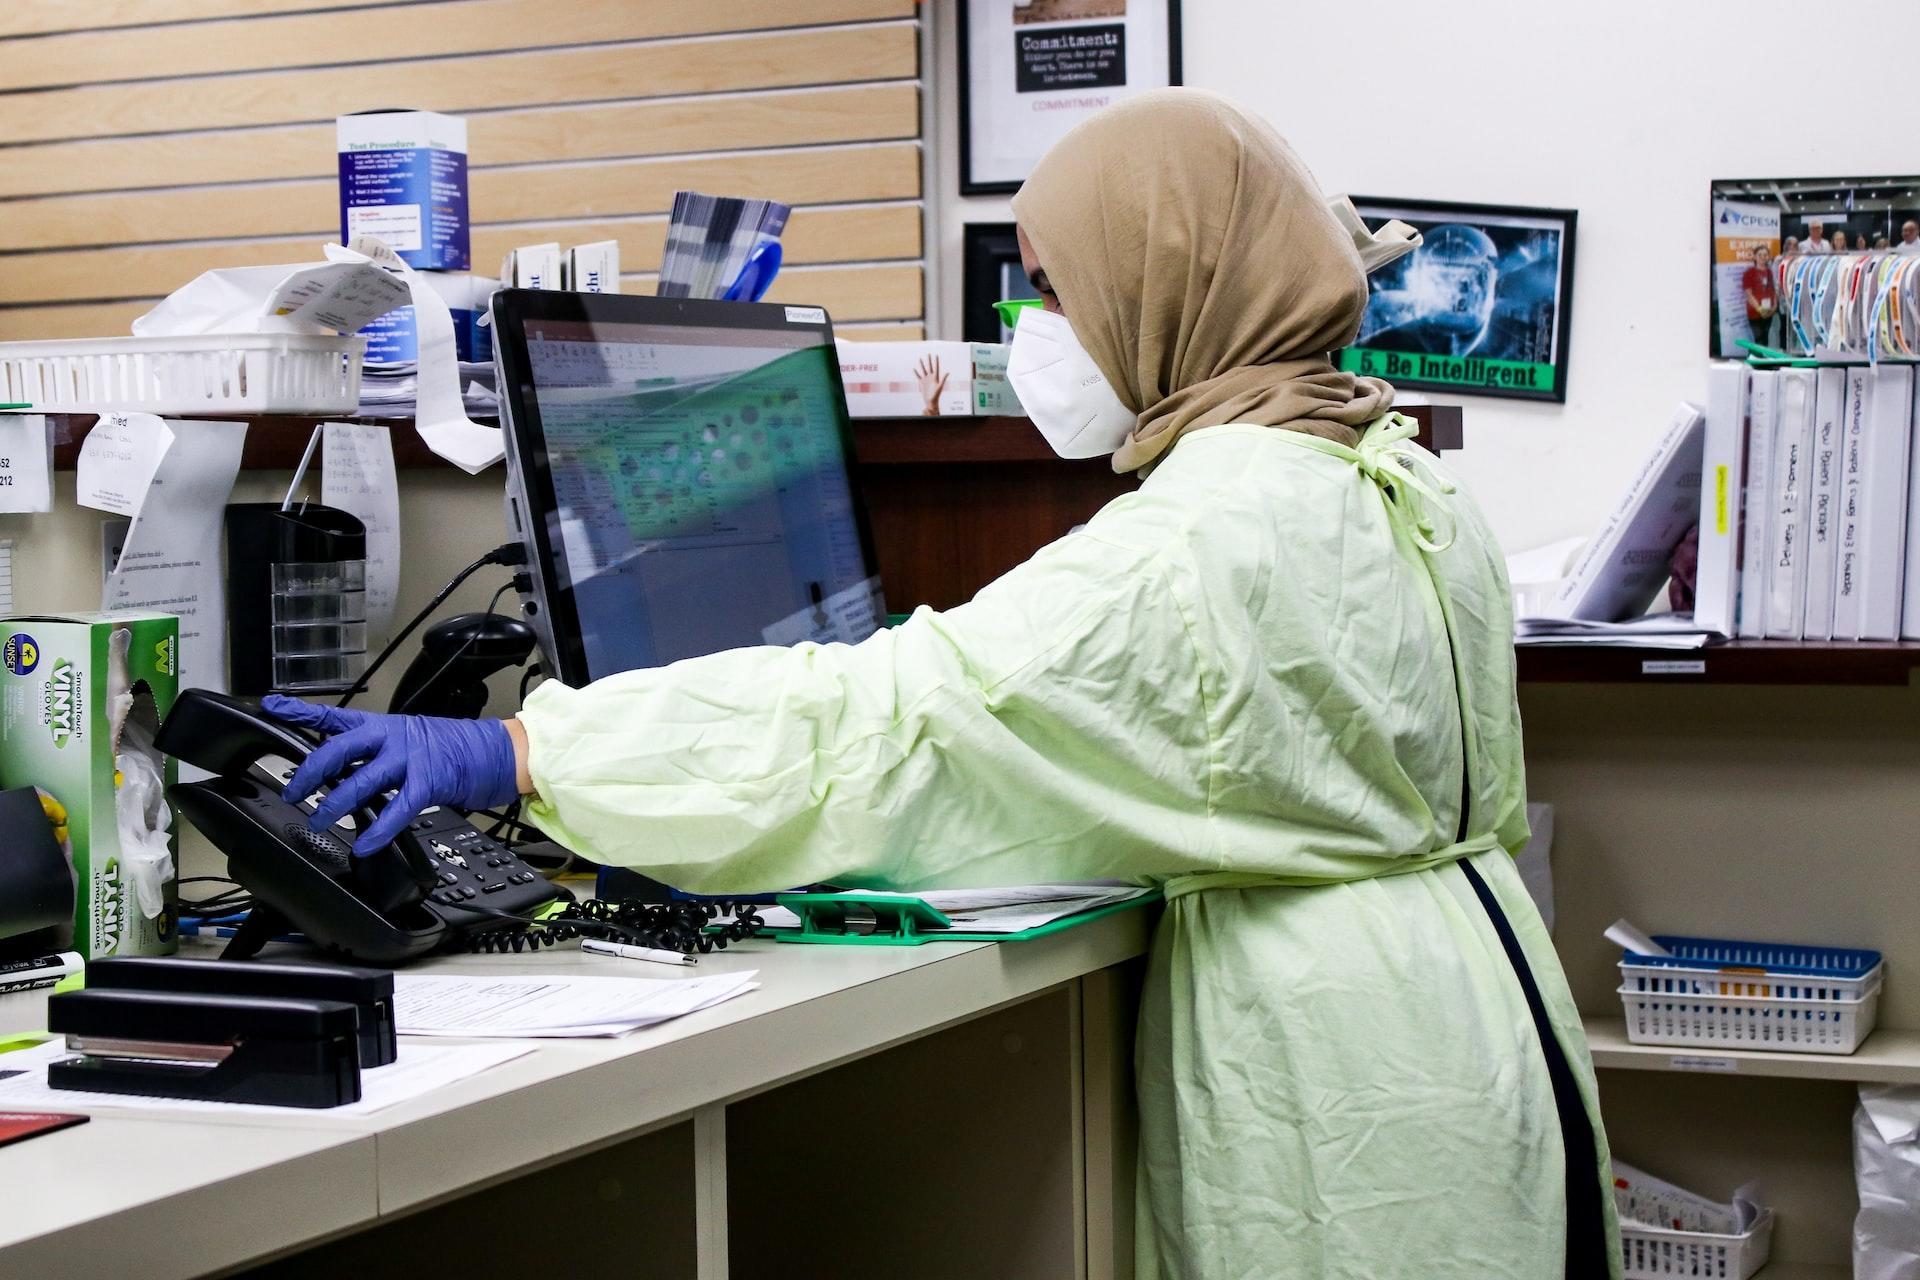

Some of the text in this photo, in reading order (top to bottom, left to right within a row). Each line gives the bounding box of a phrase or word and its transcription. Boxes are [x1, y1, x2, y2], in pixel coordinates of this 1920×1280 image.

[1032, 96, 1110, 112] COMMITMENT
[1741, 215, 1778, 227] CPESN
[840, 364, 879, 372] DER-FREE
[1360, 353, 1537, 387] 5. Be Intelligent
[1780, 523, 1794, 567] Delivery
[6, 637, 16, 673] SUNSET
[44, 681, 52, 725] GLOVES
[53, 664, 71, 742] VINYL
[103, 864, 118, 954] VINYL
